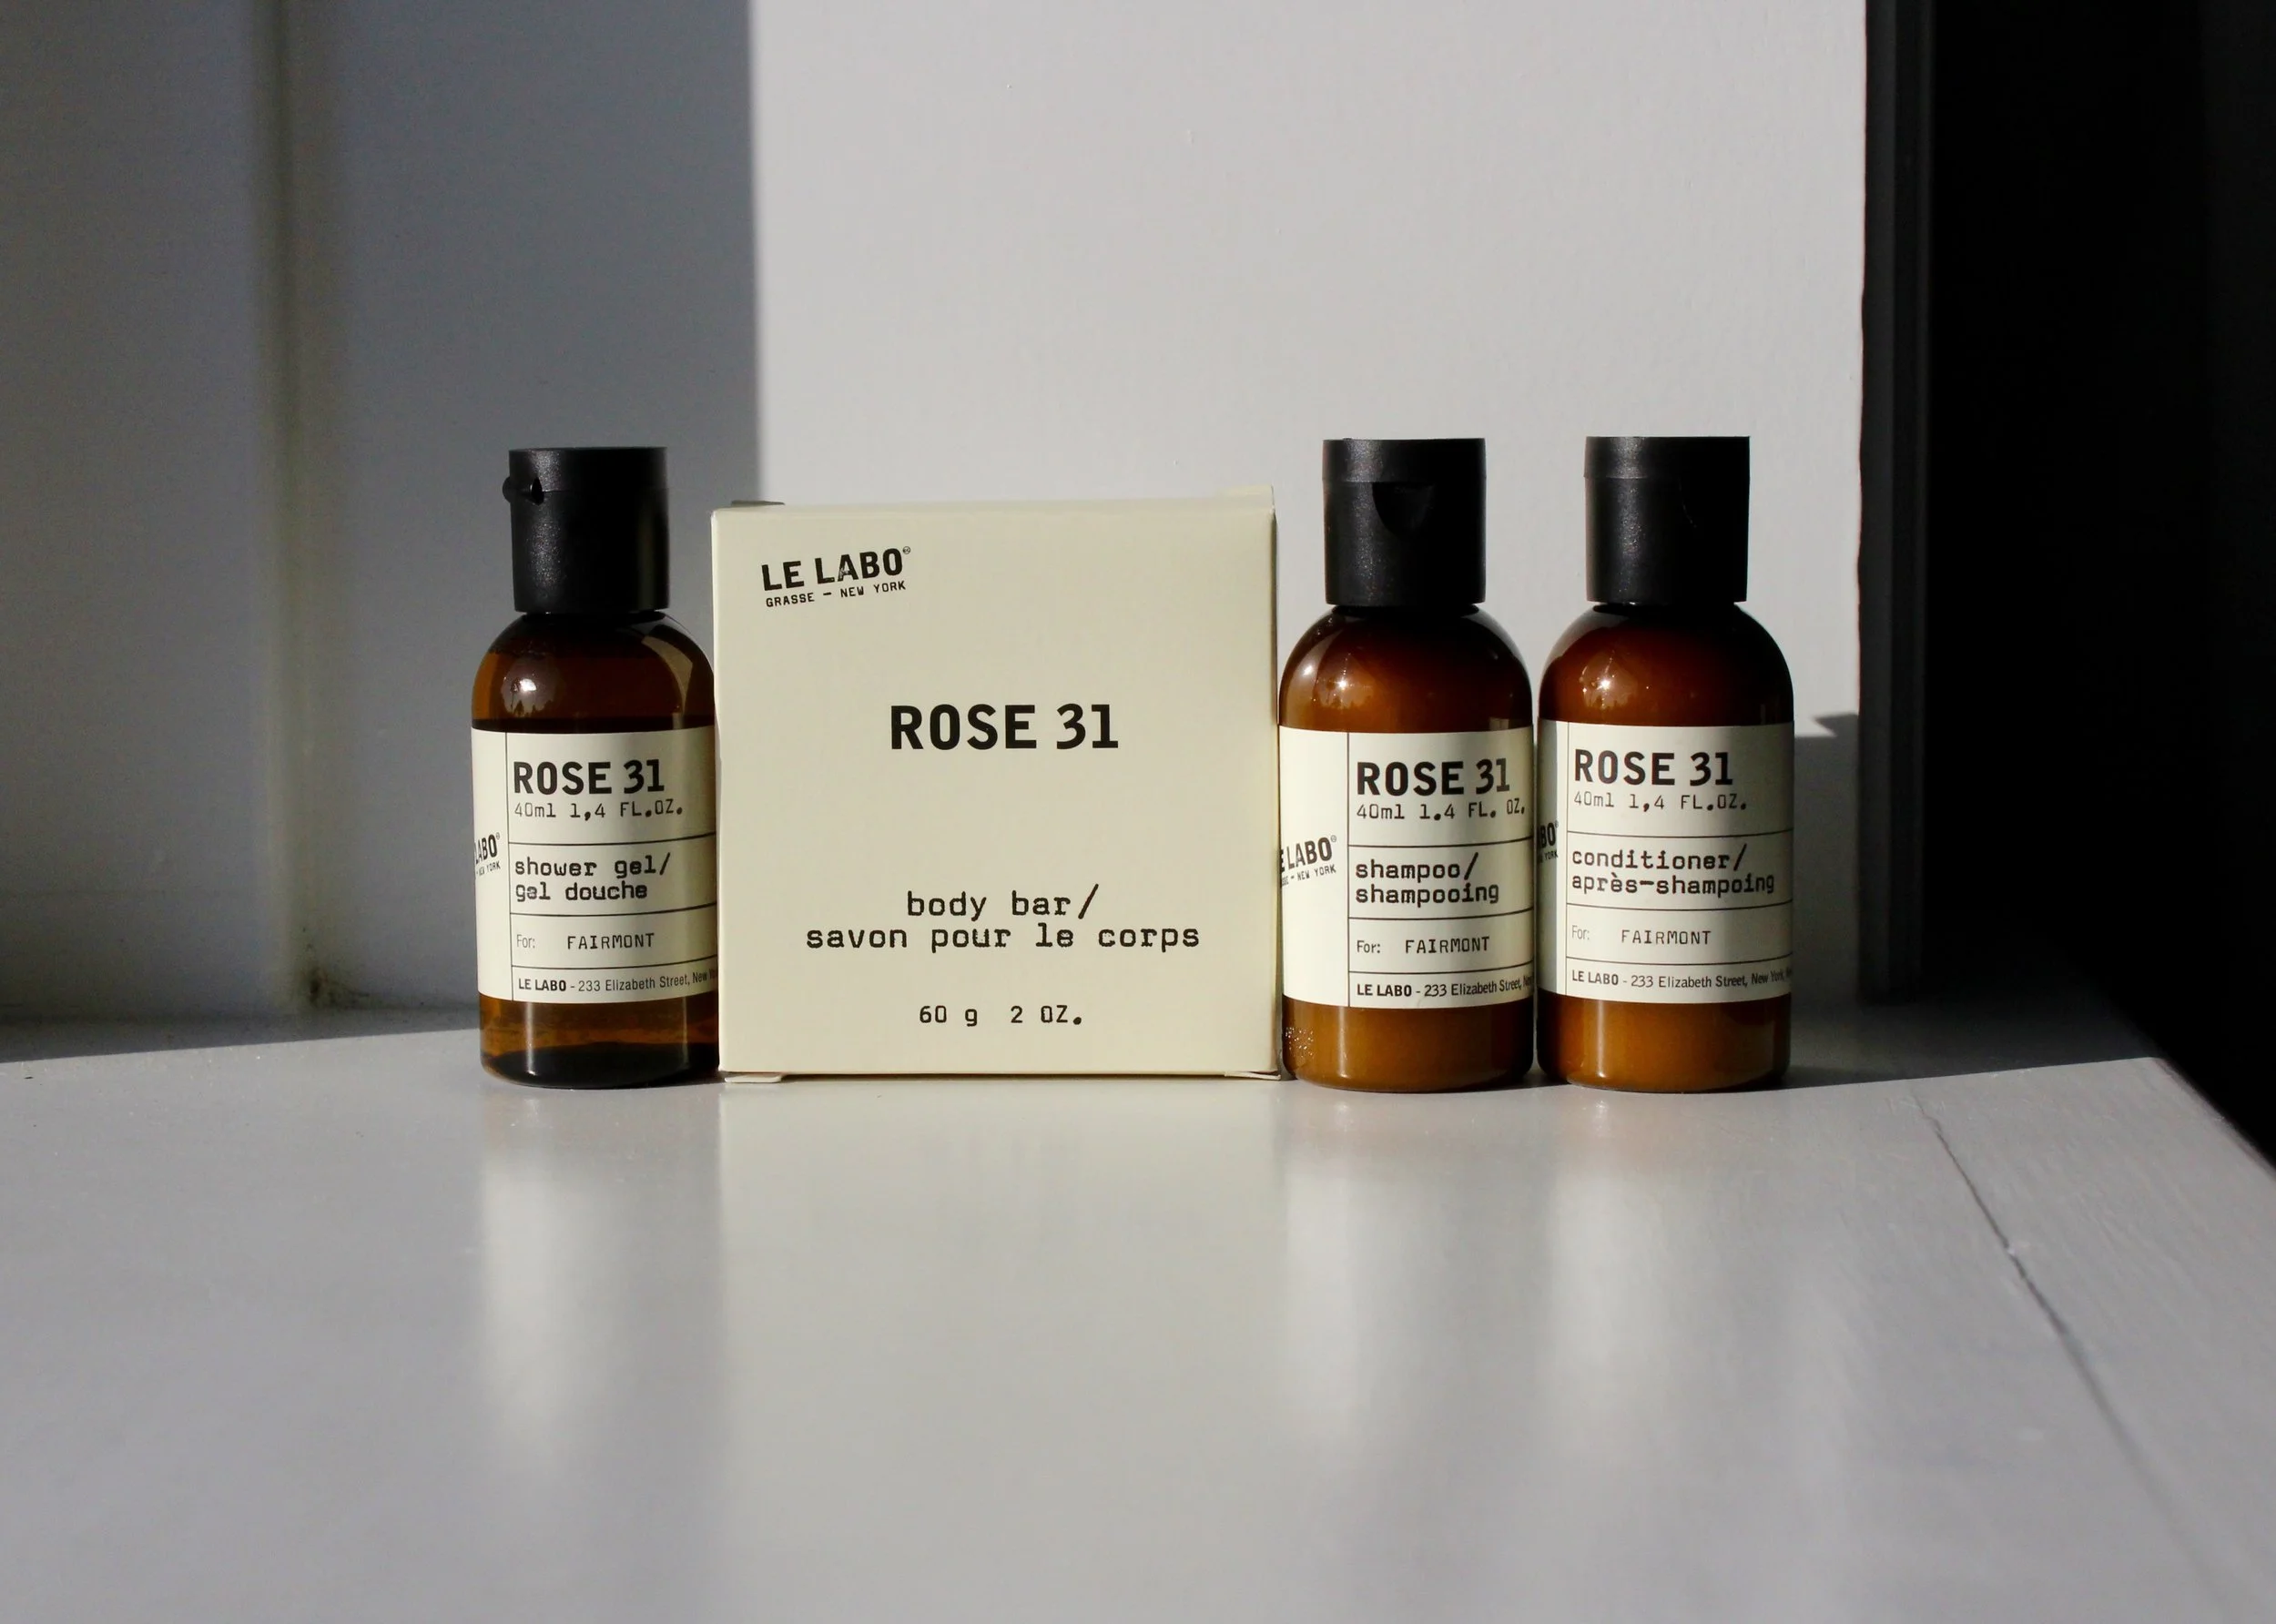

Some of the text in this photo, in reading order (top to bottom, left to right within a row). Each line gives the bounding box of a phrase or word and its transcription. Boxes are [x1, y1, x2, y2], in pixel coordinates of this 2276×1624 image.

[761, 548, 903, 591] LE LABO
[766, 593, 815, 607] GRASSE
[840, 586, 864, 598] NEW
[873, 581, 906, 594] YORK
[890, 704, 1119, 750] ROSE 31
[513, 759, 665, 795] ROSE 31
[1356, 758, 1510, 796] ROSE 31
[1574, 748, 1733, 787] ROSE 31
[514, 803, 556, 817] 40ml
[1356, 804, 1406, 819] 40ml
[1468, 802, 1497, 818] FL.
[1573, 791, 1614, 807] 40ml
[515, 852, 670, 878] shower gel/
[1286, 837, 1333, 870] LABO
[1572, 844, 1747, 871] conditioner/
[1296, 870, 1310, 881] NEW
[1314, 864, 1336, 877] YORK
[1356, 852, 1478, 883] shampoo/
[515, 881, 647, 902] gel douche
[1356, 883, 1499, 908] shampooing
[1572, 872, 1774, 898] après-shampoing
[907, 884, 1100, 921] body bar/
[516, 933, 655, 950] For: FAIRMONT
[806, 923, 1200, 953] savon pour le corps
[1356, 936, 1489, 954] For: FAIRMONT
[1572, 925, 1712, 945] For: FAIRMONT
[518, 979, 532, 990] LE
[534, 979, 566, 991] LABO
[578, 980, 601, 991] 233
[605, 978, 655, 991] Elizabeth
[659, 973, 690, 989] Street,
[692, 971, 708, 984] New
[1356, 983, 1373, 995] LE
[1377, 984, 1412, 997] LABO
[1425, 985, 1447, 998] 233
[1451, 979, 1498, 995] Elizabeth
[1499, 978, 1522, 992] Street,
[1572, 970, 1584, 982] LE
[1588, 972, 1619, 986] LABO
[1631, 976, 1653, 988] 233
[1659, 973, 1712, 988] Elizabeth
[1715, 974, 1748, 988] Street,
[1751, 972, 1769, 984] New
[920, 1005, 1082, 1027] 60 g 2 OZ.
